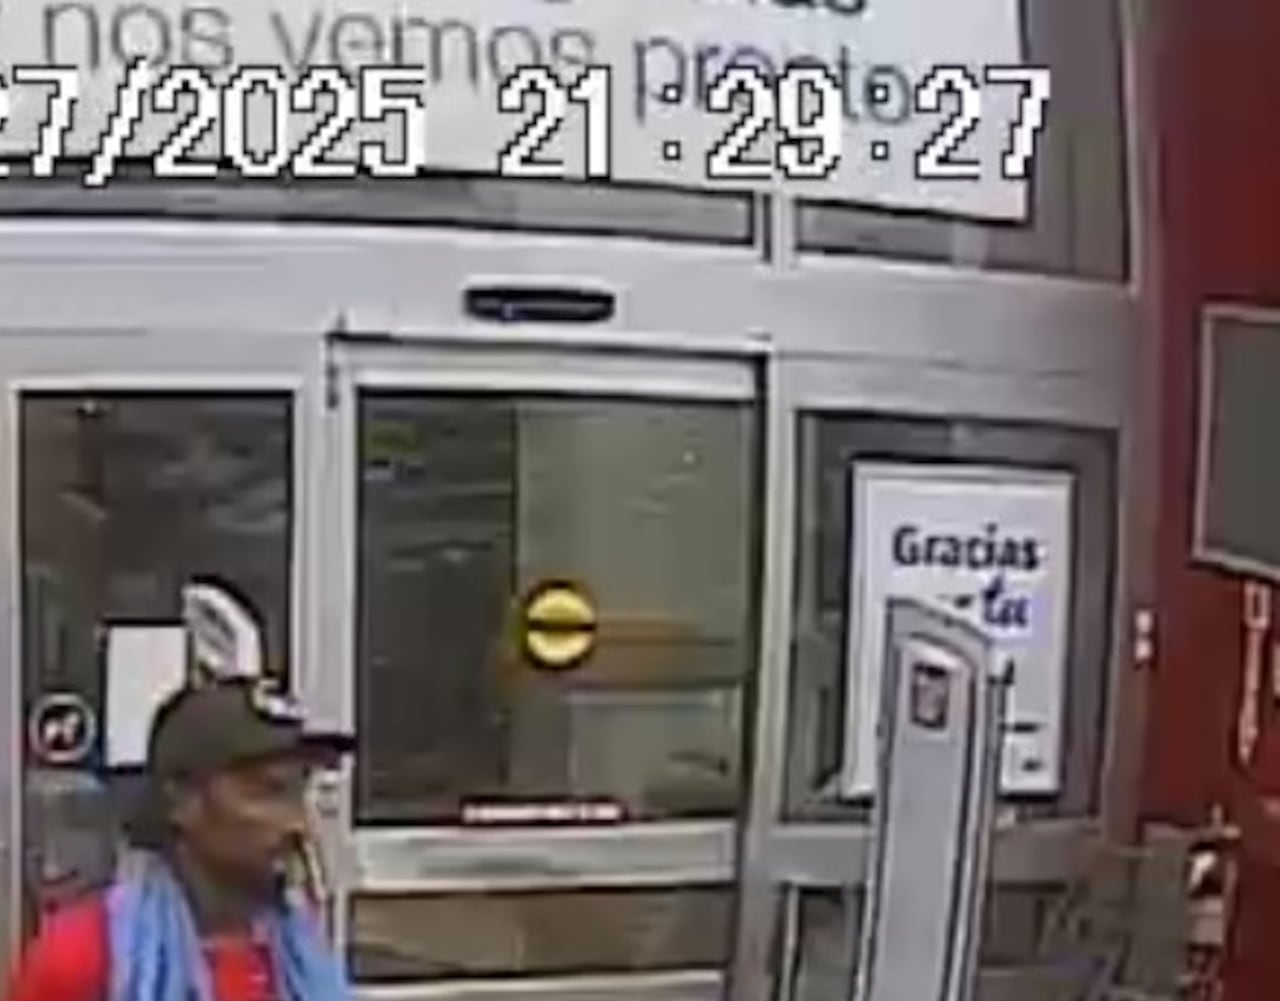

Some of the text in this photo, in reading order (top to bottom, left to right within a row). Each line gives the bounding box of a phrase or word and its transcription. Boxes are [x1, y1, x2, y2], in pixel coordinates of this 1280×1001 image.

[42, 2, 232, 70] nos
[271, 12, 596, 88] vemos
[633, 37, 913, 127] prto
[893, 523, 1040, 569] Gracias
